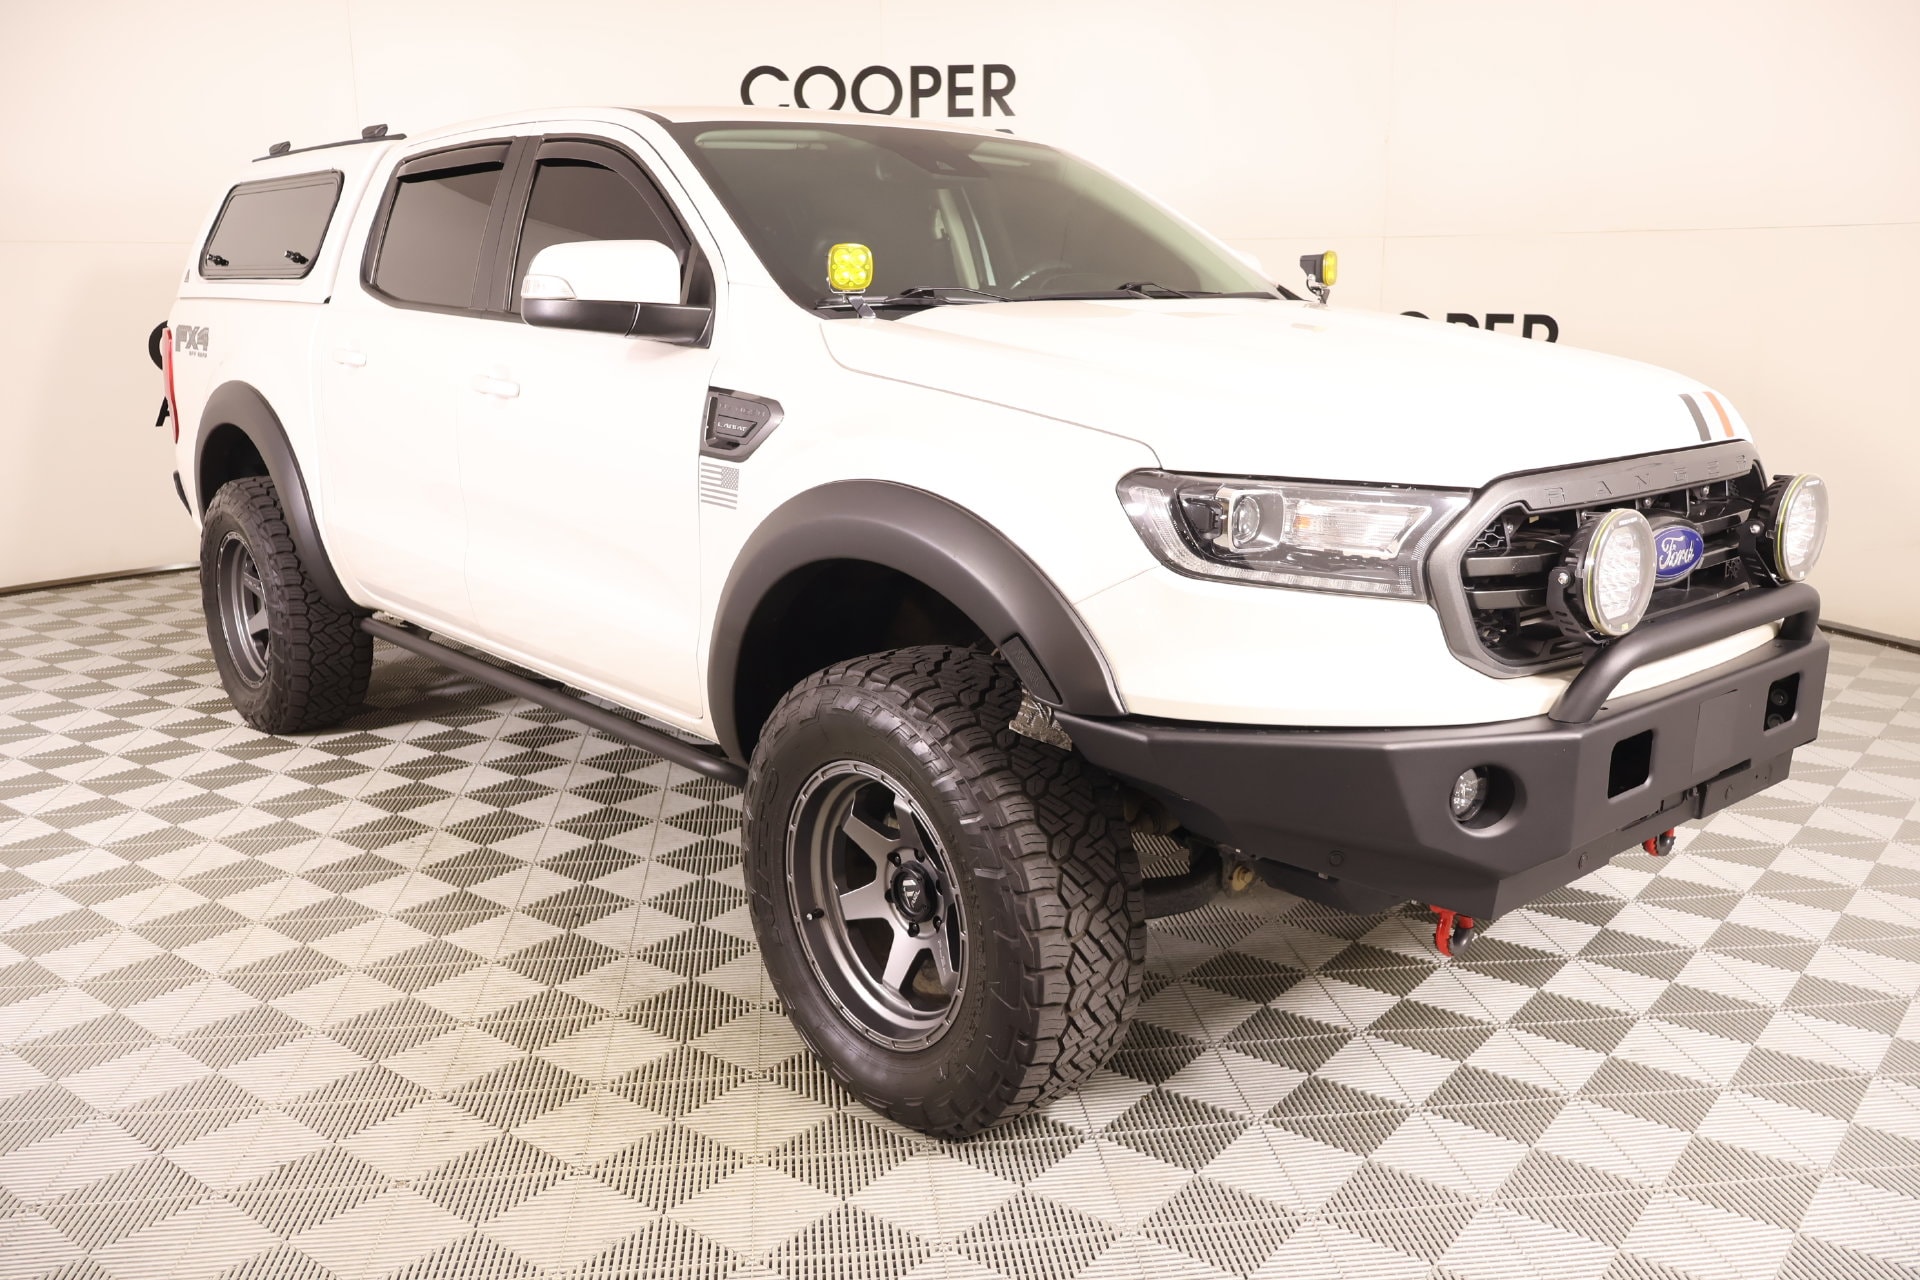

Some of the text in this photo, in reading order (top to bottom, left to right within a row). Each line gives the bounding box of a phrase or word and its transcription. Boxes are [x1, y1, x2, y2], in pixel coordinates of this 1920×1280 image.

[740, 64, 1016, 118] COOPER
[1543, 454, 1748, 505] RANGER
[1659, 535, 1695, 570] Ford
